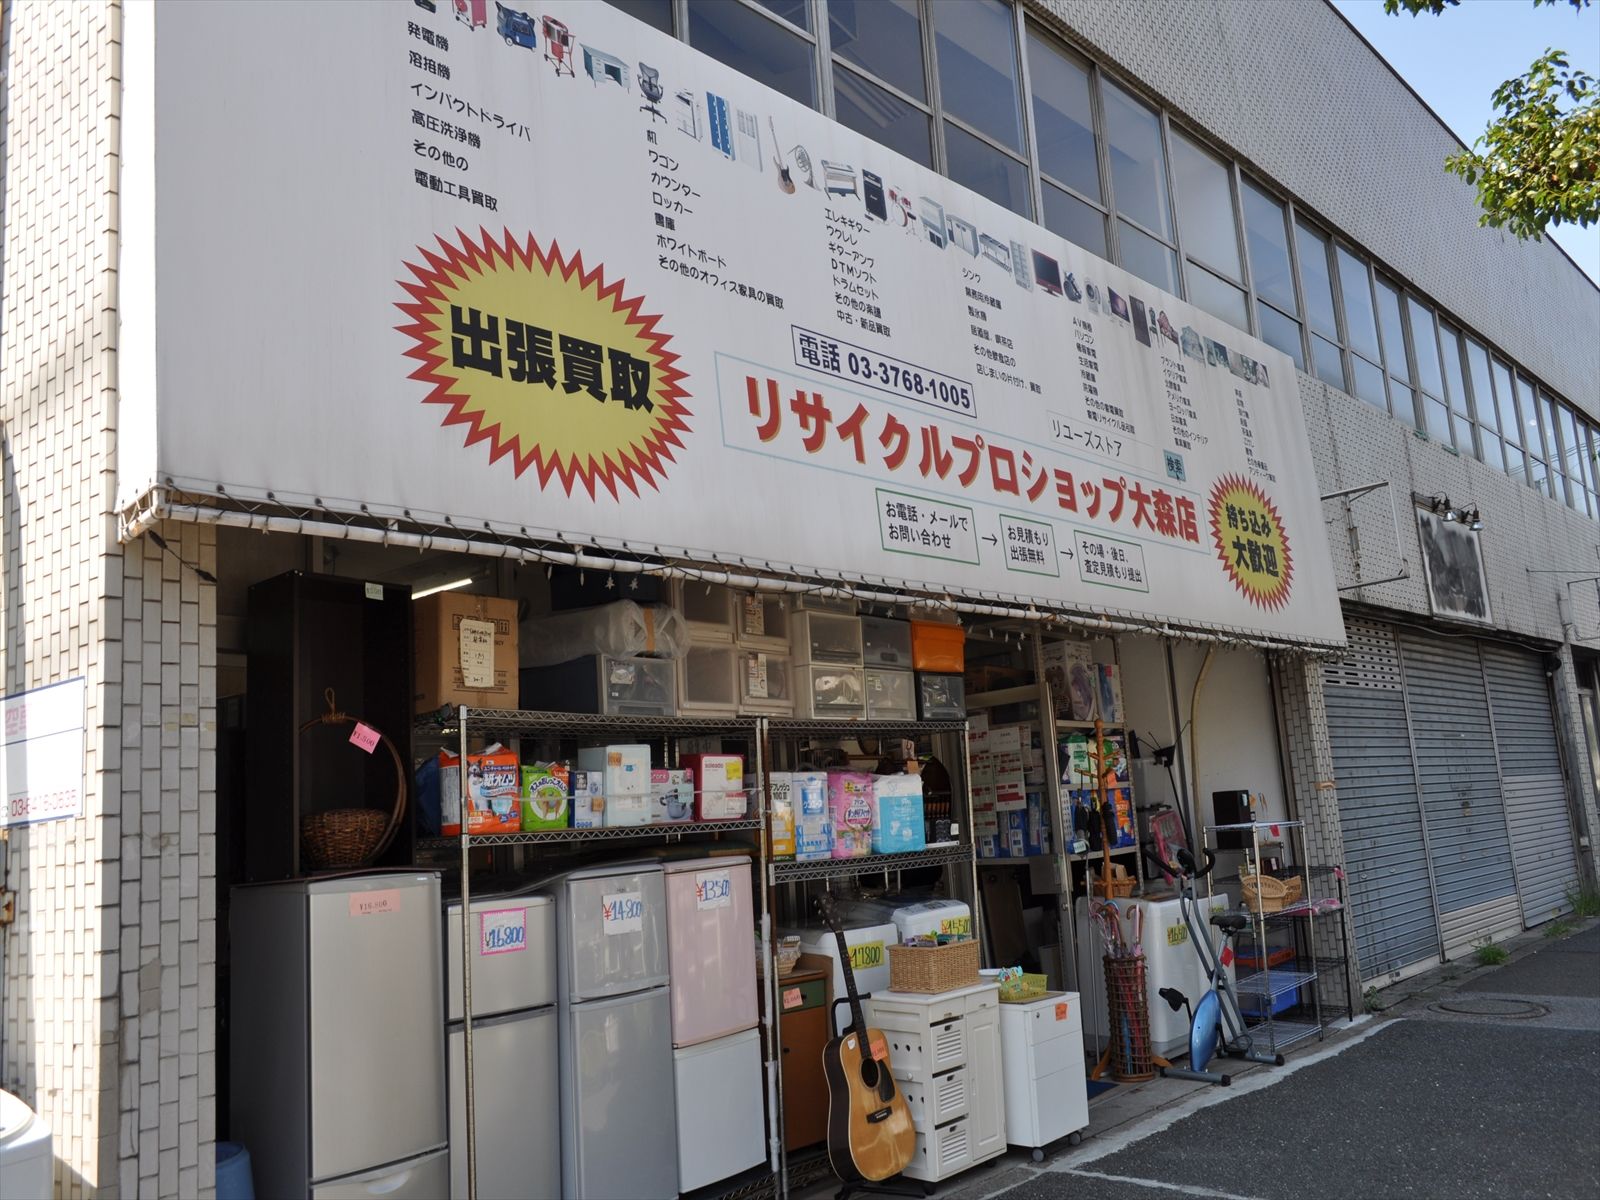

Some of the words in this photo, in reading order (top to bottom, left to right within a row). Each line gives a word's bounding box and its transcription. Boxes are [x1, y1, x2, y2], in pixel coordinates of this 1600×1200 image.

[407, 22, 449, 52] 発電機
[409, 50, 451, 81] 溶接機
[411, 109, 482, 150] 高圧洗浄機
[646, 130, 658, 145] 机
[413, 141, 469, 172] その他の
[648, 150, 679, 172] ワゴン
[413, 169, 498, 212] 電動工具買取
[651, 172, 701, 199] カウンター
[652, 193, 693, 215] ロッカー
[655, 212, 676, 232] 書庫
[824, 207, 871, 233] エレキギター
[826, 224, 858, 246] ウクレレ
[656, 235, 728, 268] ホワイトボード
[658, 255, 785, 310] その他のオフィス家具の買取
[833, 275, 879, 301] ドラムセット
[962, 267, 982, 283] シンク
[837, 310, 891, 338] 中古・新品買取
[1074, 330, 1095, 344] パソコン
[449, 304, 655, 414] 出張買取
[799, 333, 841, 374] 電話
[847, 352, 971, 410] 03-3768-1005
[746, 376, 1201, 545] リサイクルプロショップ大森店
[1166, 455, 1183, 475] 検索
[885, 499, 969, 533] お電話・メールで
[1225, 501, 1272, 540] 持ち込み
[888, 523, 952, 550] お問い合わせ
[1007, 525, 1050, 547] お見積もり
[1010, 545, 1046, 565] 出張無料
[1082, 540, 1129, 564] その場・後日、
[1231, 537, 1280, 579] 大歓迎
[1085, 560, 1143, 583] 査定見積もり提出
